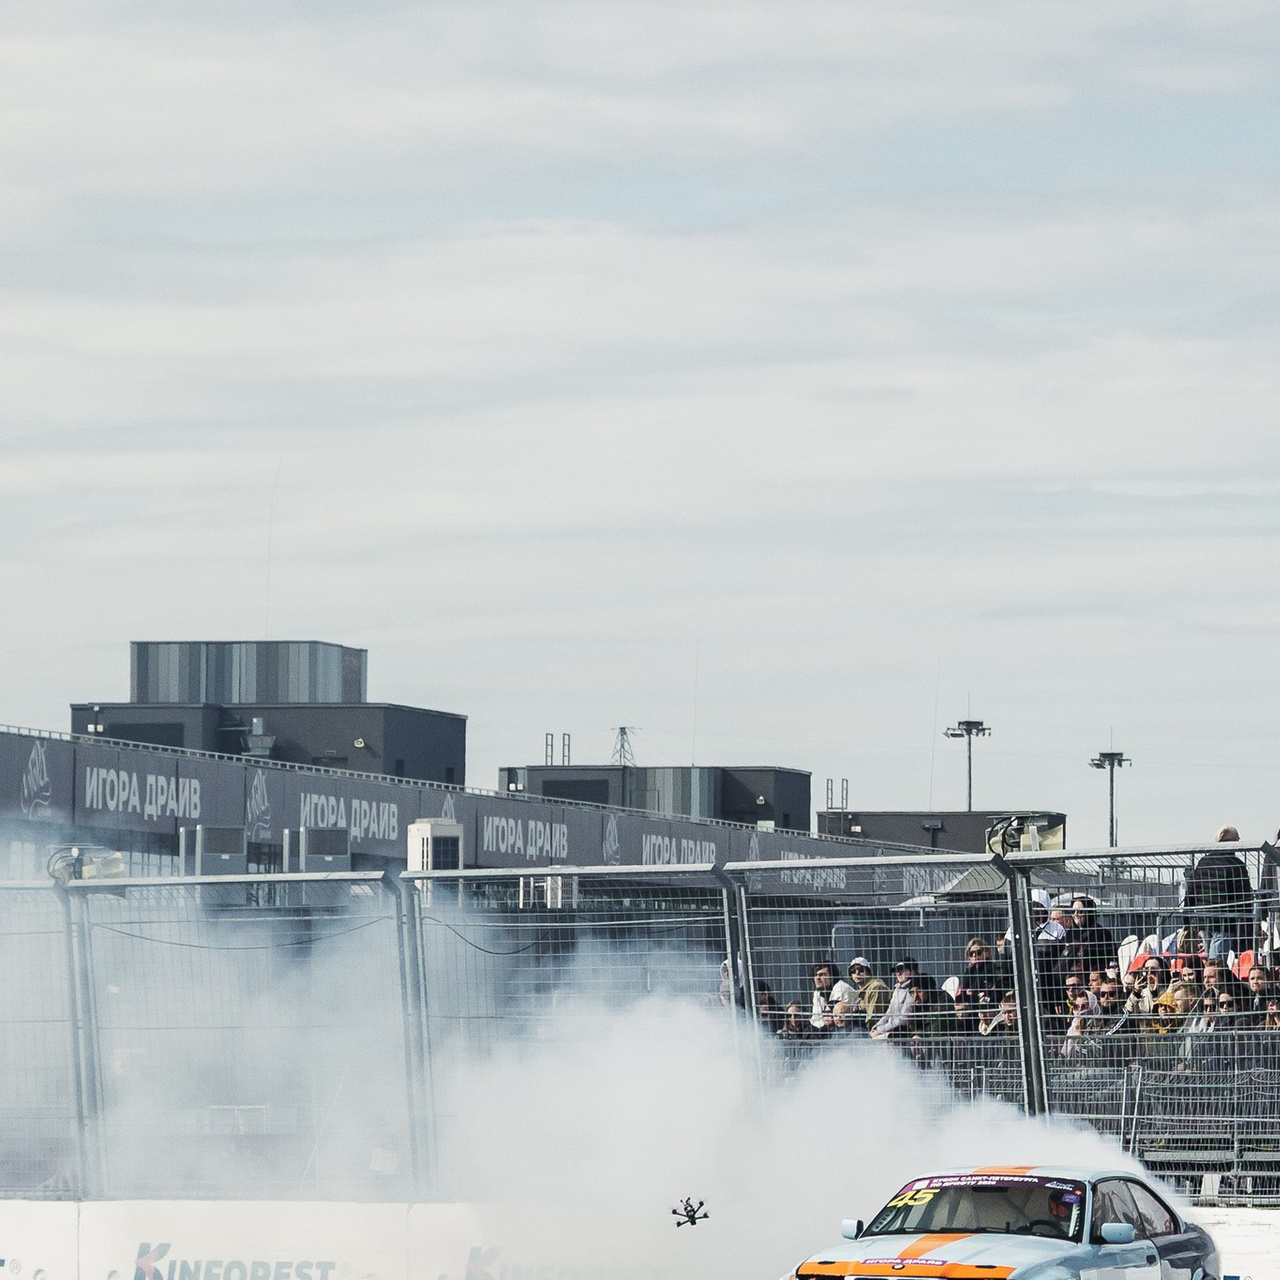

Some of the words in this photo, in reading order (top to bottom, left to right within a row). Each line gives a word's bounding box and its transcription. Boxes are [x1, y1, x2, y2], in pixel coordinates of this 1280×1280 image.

[85, 766, 141, 814] ИГОРА
[300, 792, 347, 828] ИГОРА
[483, 815, 524, 855] ИГОРА
[642, 833, 677, 866] ИГОРА
[886, 1188, 941, 1208] 45
